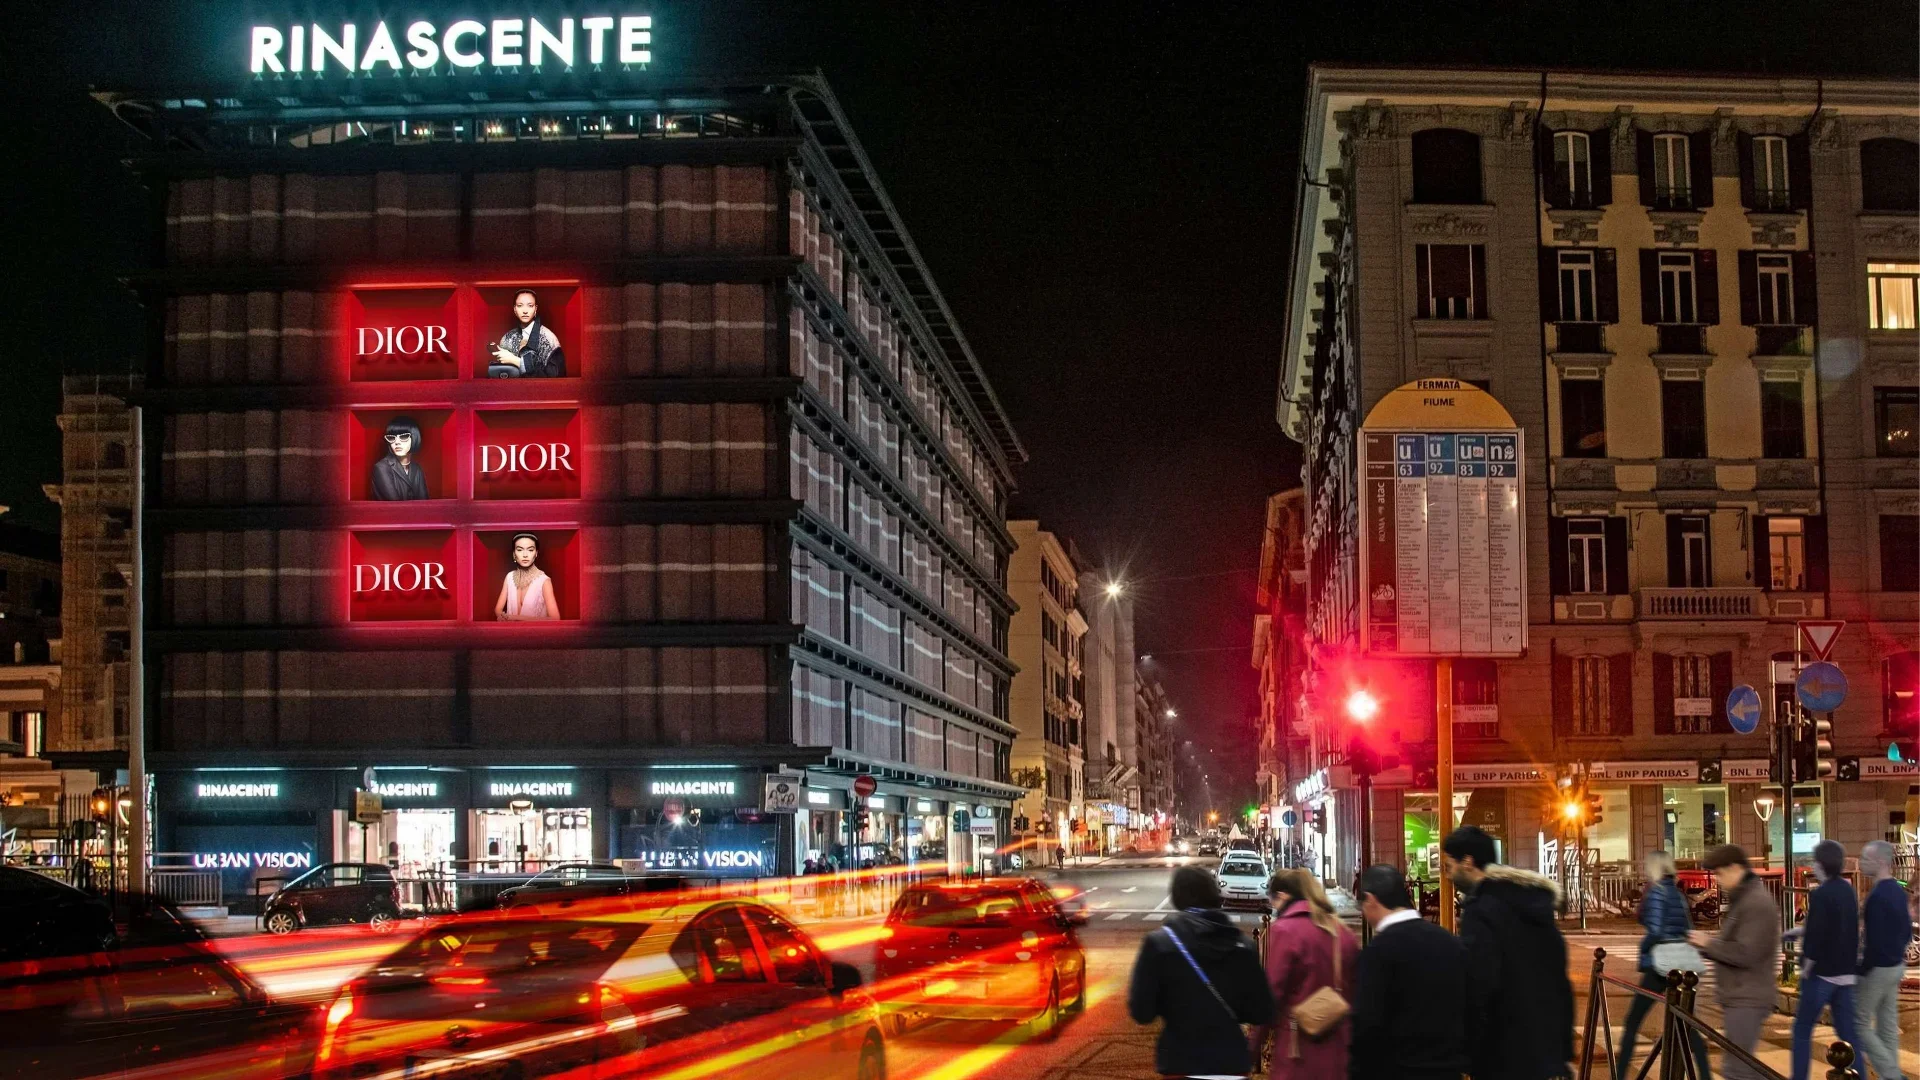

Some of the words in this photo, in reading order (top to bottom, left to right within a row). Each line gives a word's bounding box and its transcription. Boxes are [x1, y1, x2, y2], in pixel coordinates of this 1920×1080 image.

[251, 16, 652, 73] RINASCENTE
[356, 325, 450, 355] DIOR
[1417, 380, 1460, 390] FERMATA
[1424, 398, 1455, 406] FIUME
[1399, 445, 1411, 460] u
[1430, 443, 1441, 458] u
[1460, 445, 1472, 460] u
[1490, 445, 1503, 460] n
[479, 442, 574, 473] DIOR
[1399, 464, 1412, 476] 63
[1430, 462, 1443, 474] 92
[1460, 464, 1473, 476] 83
[1490, 464, 1504, 477] 92
[1377, 482, 1385, 504] atac
[1378, 517, 1386, 542] ROMA
[352, 562, 448, 593] DIOR
[1454, 772, 1469, 781] NL
[1473, 772, 1497, 780] BNP
[1500, 771, 1548, 780] PARIBAS
[1590, 771, 1612, 779] BNL
[1616, 770, 1640, 778] BNP
[1642, 769, 1690, 778] PARIBAS
[1730, 768, 1752, 776] BNL
[1867, 765, 1889, 774] BNL
[1892, 765, 1915, 773] BNP
[198, 784, 279, 797] RINASCENTE
[490, 783, 572, 796] RINASCENTE
[652, 782, 735, 795] RINASCENTE
[194, 852, 250, 868] URBAN
[253, 852, 311, 868] VISION
[703, 850, 762, 867] VISION
